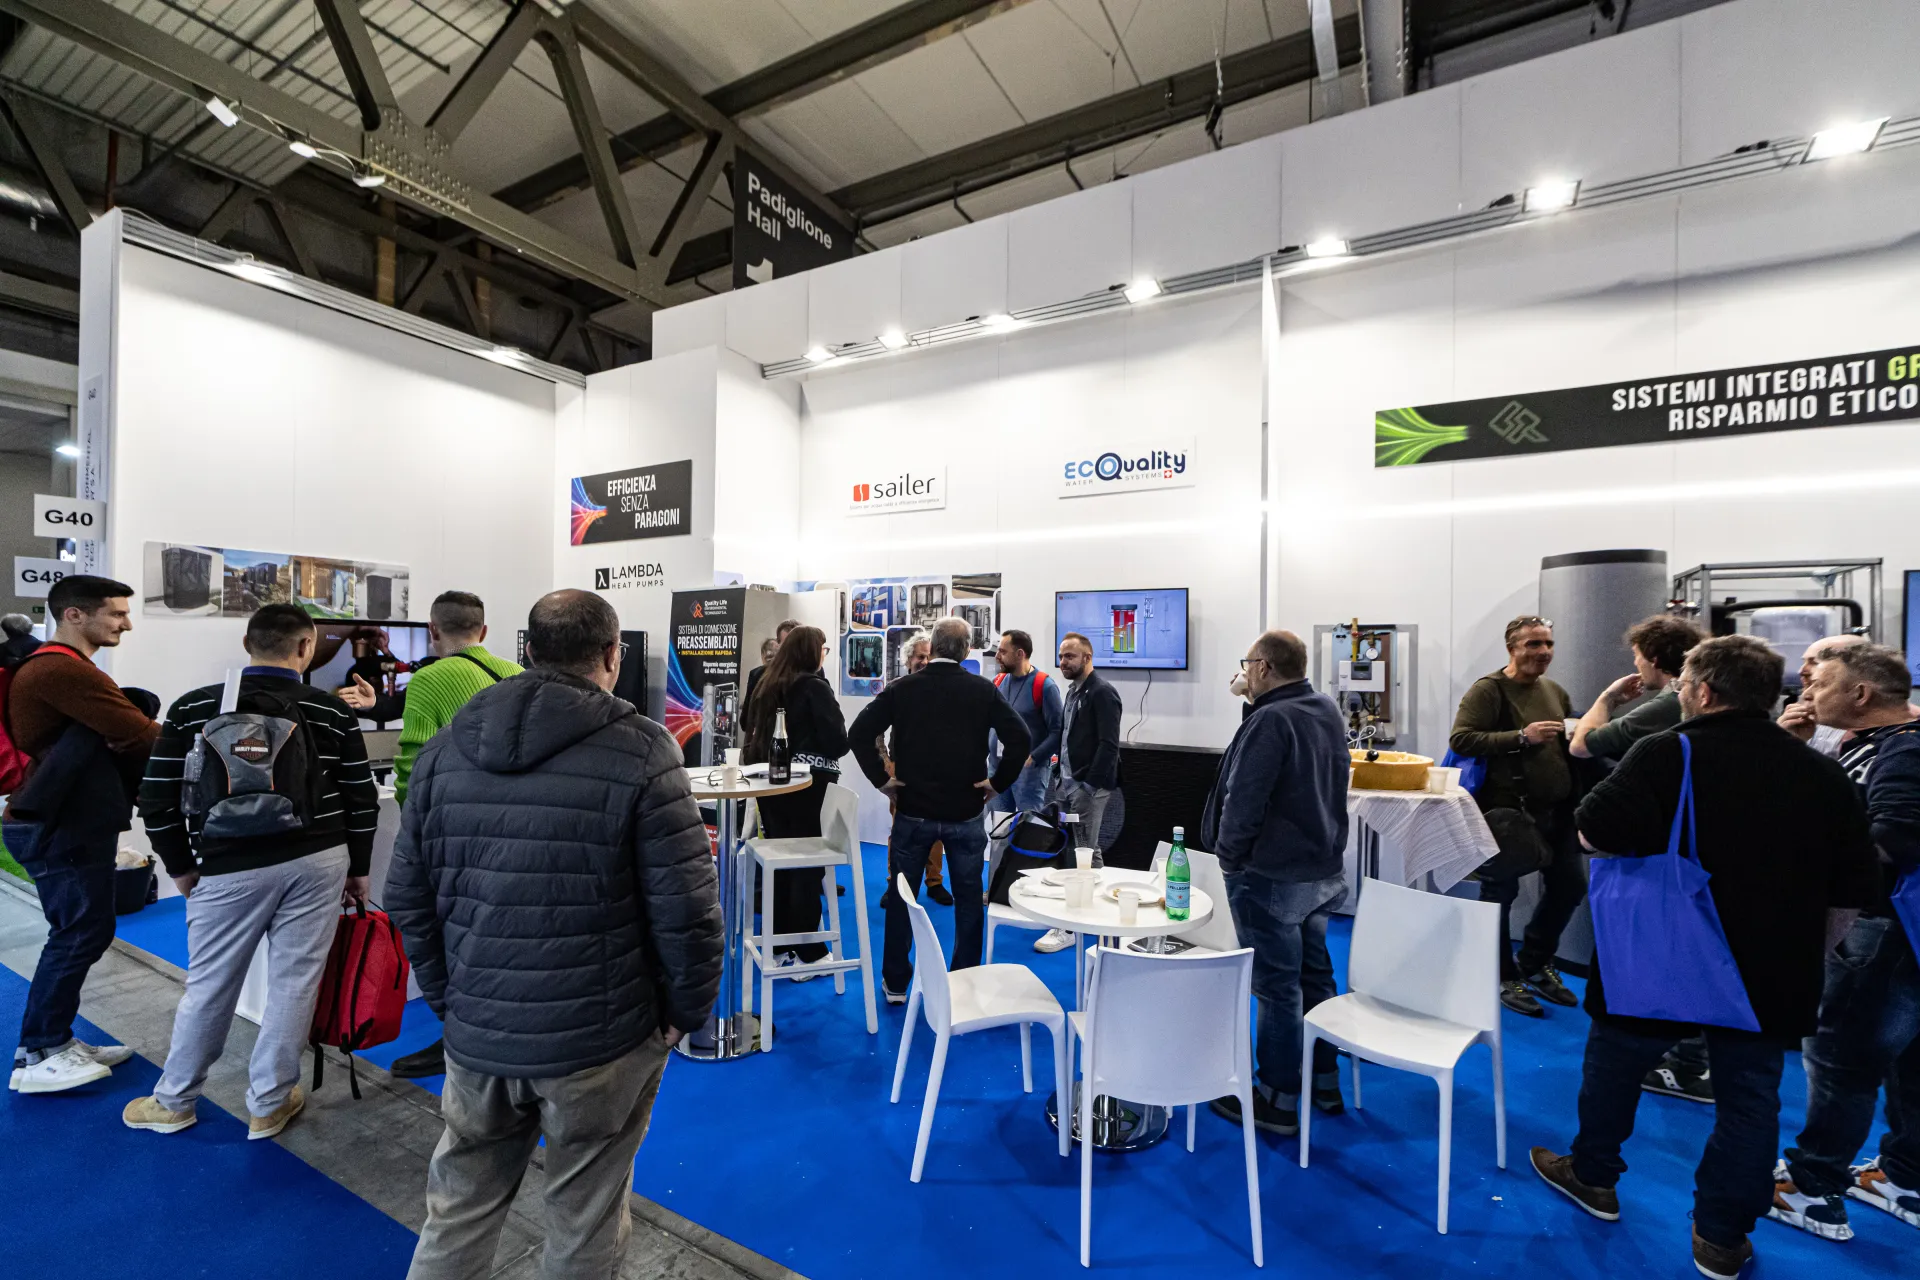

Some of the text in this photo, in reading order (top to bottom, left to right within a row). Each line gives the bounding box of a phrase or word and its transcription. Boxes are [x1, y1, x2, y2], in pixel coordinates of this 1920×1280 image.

[748, 171, 833, 249] Padiglione
[747, 200, 781, 242] Hall
[1611, 377, 1716, 412] SISTEMI
[1726, 359, 1876, 399] INTEGRATI
[1668, 383, 1919, 432] RISPARMIO ETICO
[607, 474, 657, 497] EFFICIENZA
[873, 472, 936, 499] sailer
[1065, 472, 1163, 487] WATER SYSTEMS
[620, 493, 650, 513] SENZA
[44, 509, 94, 527] G40
[634, 507, 680, 529] PARAGONI
[21, 569, 64, 584] G48
[611, 562, 664, 580] LAMBDA
[611, 579, 664, 590] HEAT PUMPS
[678, 623, 738, 635] SISTEMA DI CONNESSIONE
[677, 635, 738, 650] PREASSEMBLATO
